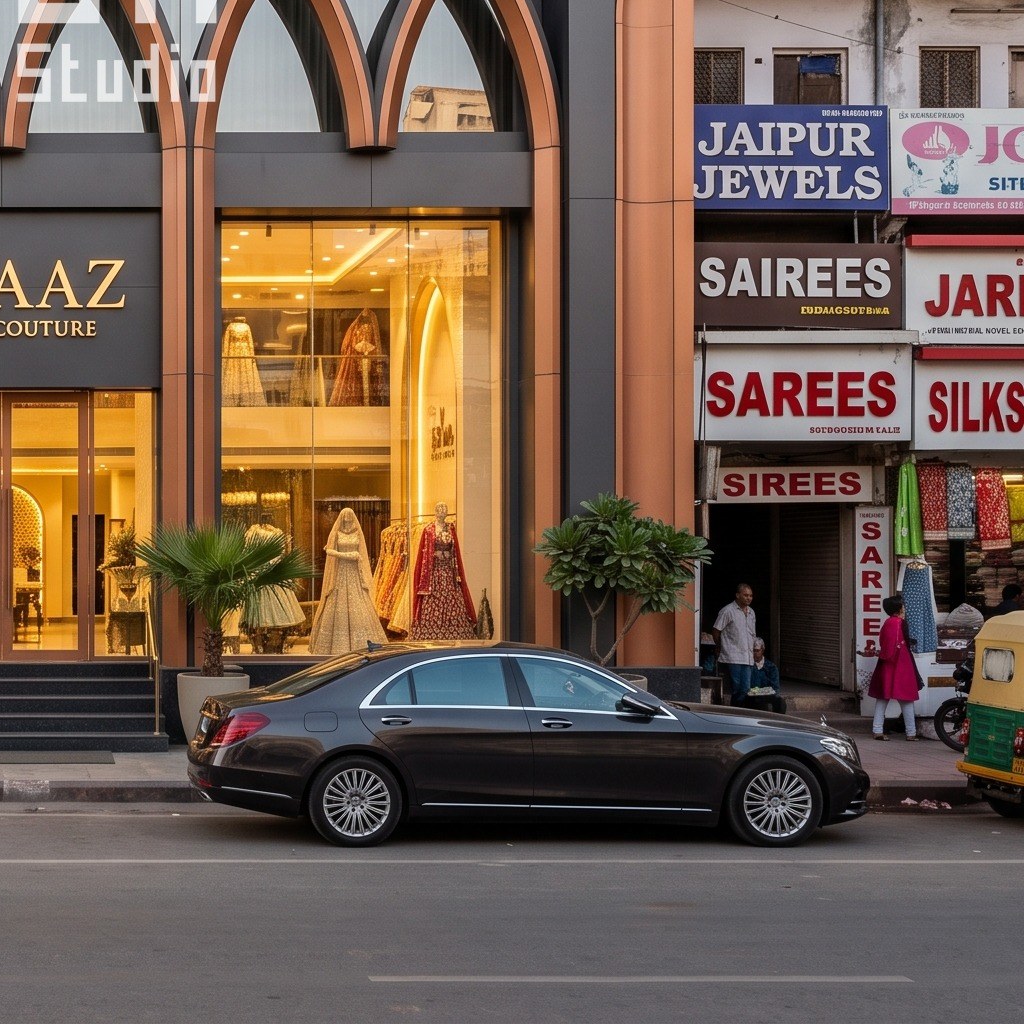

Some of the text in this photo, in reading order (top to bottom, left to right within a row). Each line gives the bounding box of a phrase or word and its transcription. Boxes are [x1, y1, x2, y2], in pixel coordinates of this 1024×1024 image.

[698, 122, 875, 157] JAIPUR
[694, 165, 883, 200] JEWELS
[699, 257, 892, 298] SAIREES
[706, 371, 897, 417] SAREES
[928, 381, 1024, 432] SILKS
[723, 472, 862, 497] SIREES
